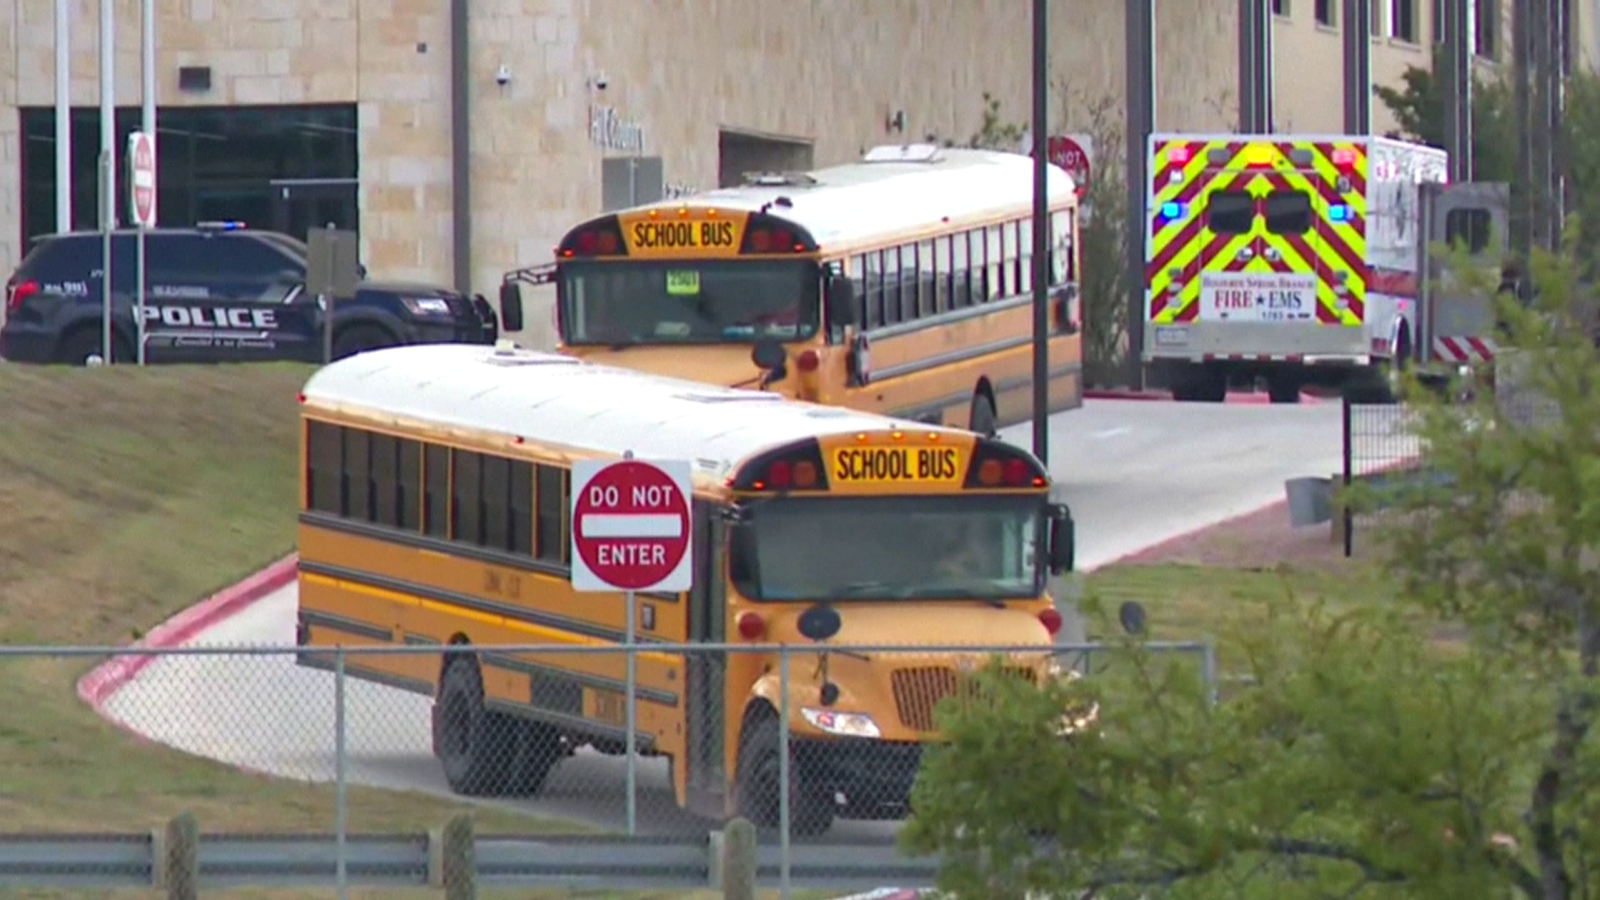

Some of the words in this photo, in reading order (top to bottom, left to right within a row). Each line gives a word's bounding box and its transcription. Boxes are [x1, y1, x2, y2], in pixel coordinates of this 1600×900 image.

[1056, 151, 1081, 166] NOT
[634, 222, 698, 248] SCHOOL
[701, 222, 733, 247] BUS
[1214, 290, 1253, 308] FIRE
[1268, 291, 1302, 309] EMS
[131, 304, 278, 328] POLICE
[837, 449, 913, 480] SCHOOL
[919, 449, 955, 479] BUS
[590, 486, 619, 507] DO
[632, 486, 673, 507] NOT
[598, 544, 666, 566] ENTER
